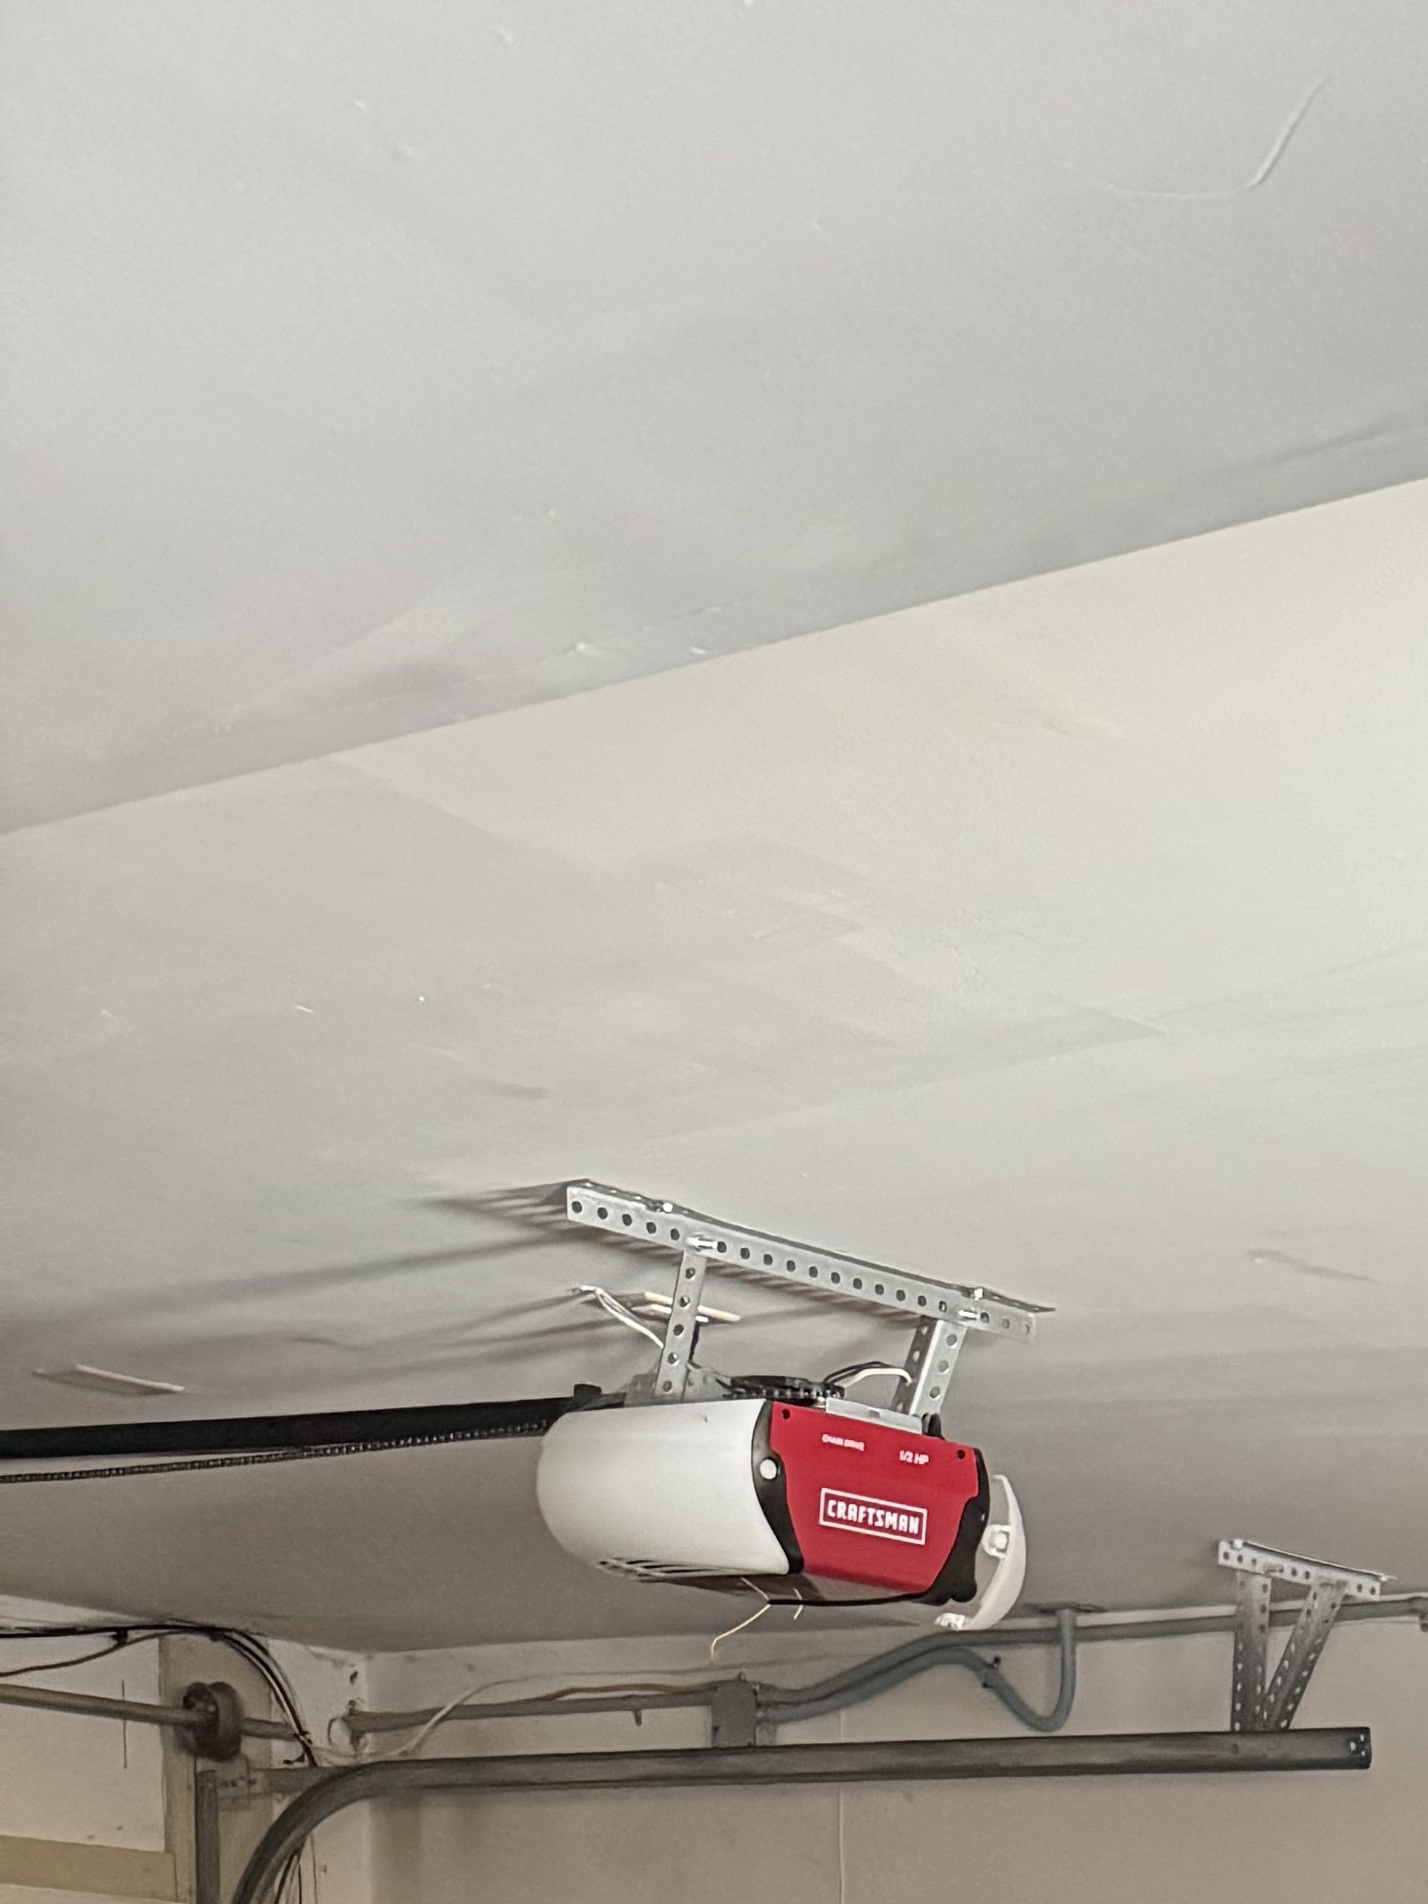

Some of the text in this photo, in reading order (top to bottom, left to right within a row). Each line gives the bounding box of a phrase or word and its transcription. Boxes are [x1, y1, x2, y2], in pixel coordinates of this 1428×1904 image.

[900, 1450, 930, 1465] 1/2 HP
[827, 1499, 920, 1534] CRAFTSMAN
